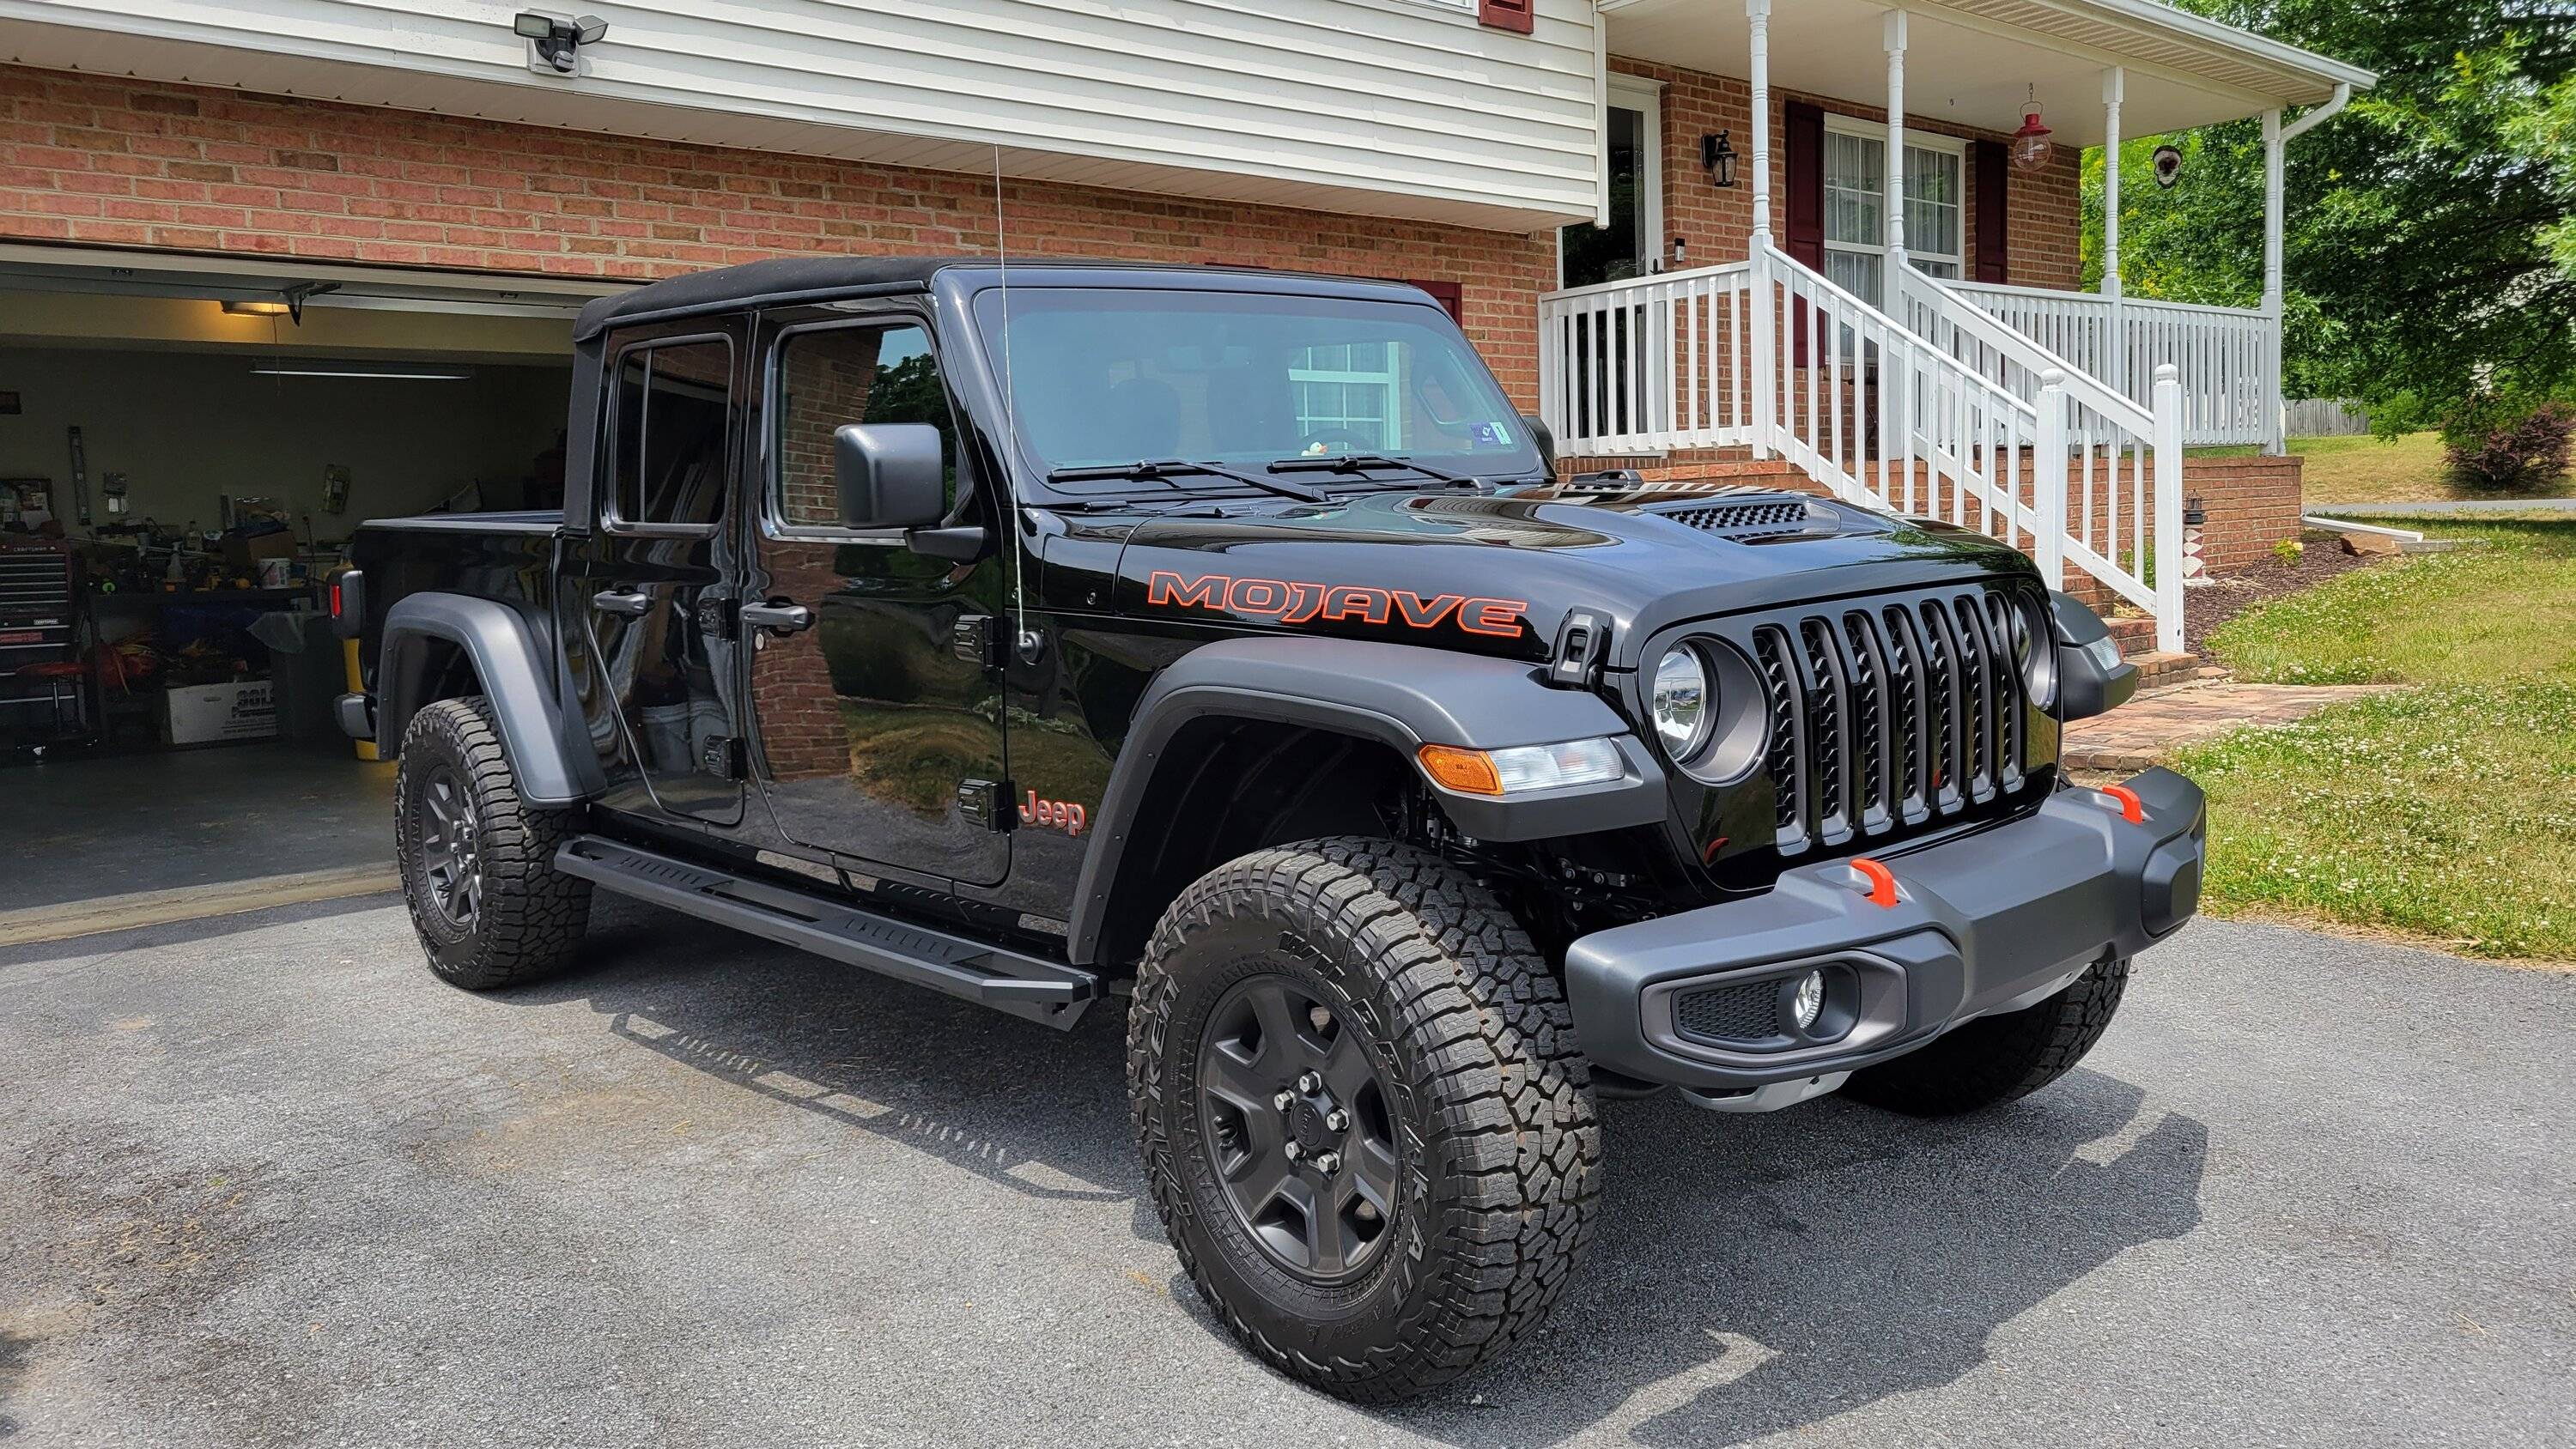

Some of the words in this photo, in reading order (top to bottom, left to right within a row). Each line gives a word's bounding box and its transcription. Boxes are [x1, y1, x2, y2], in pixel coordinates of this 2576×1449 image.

[1148, 570, 1528, 638] MOJAVE
[1018, 789, 1086, 835] Jeep
[1146, 974, 1194, 1228] FALKEN
